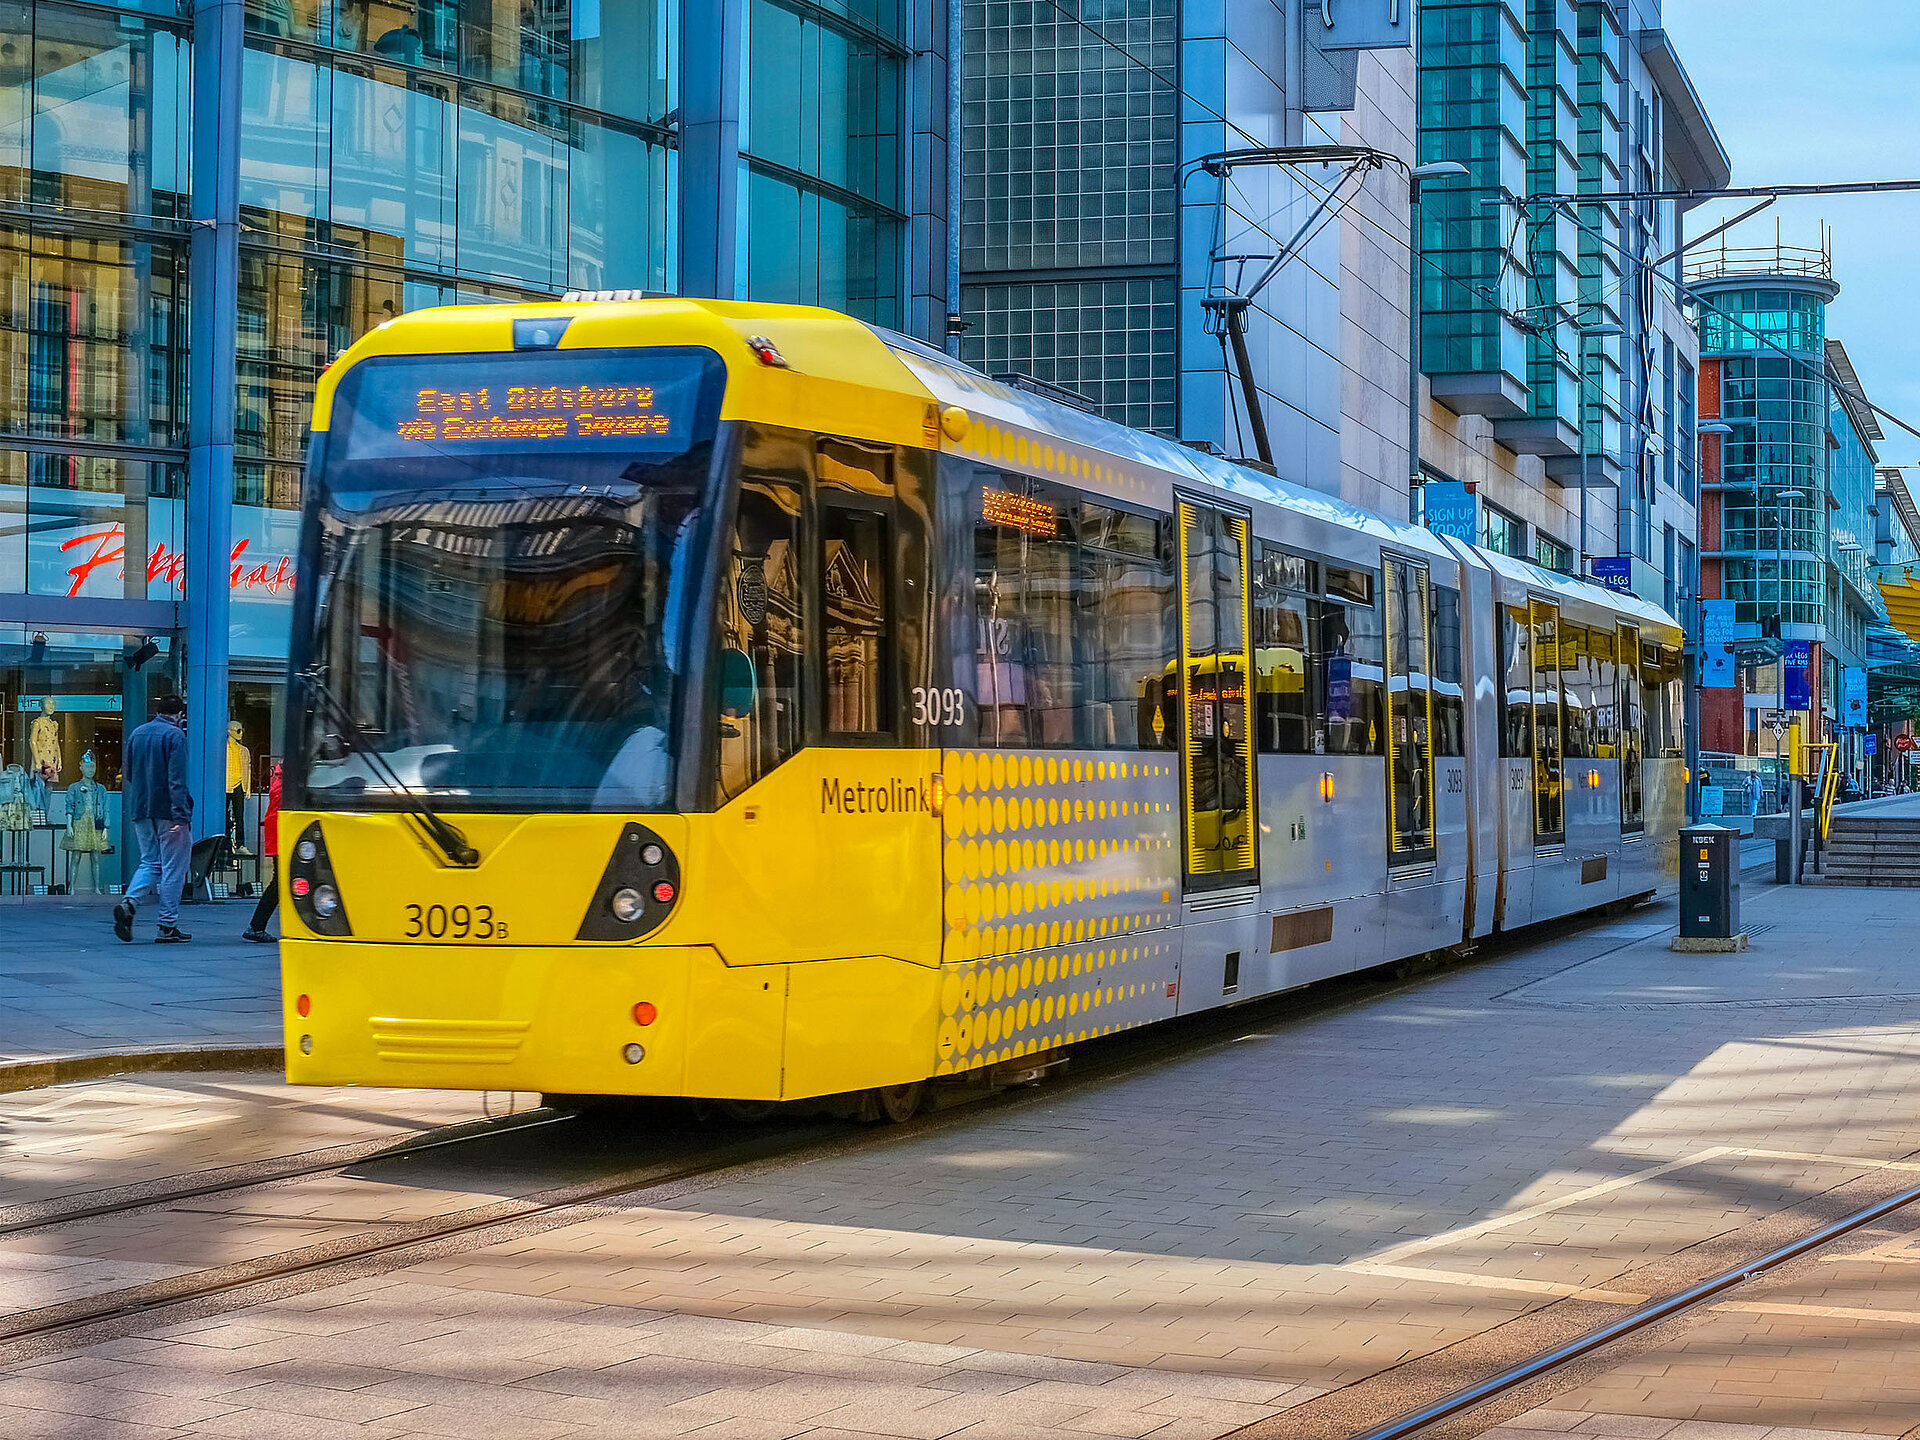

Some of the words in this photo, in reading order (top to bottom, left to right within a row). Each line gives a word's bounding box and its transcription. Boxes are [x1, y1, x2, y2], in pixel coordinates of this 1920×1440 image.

[417, 388, 490, 413] East
[1428, 508, 1455, 521] SIGN
[1458, 507, 1473, 520] UP
[1428, 522, 1473, 537] TODAY
[1608, 575, 1629, 585] LEGS
[1706, 628, 1720, 636] DOG
[912, 687, 964, 726] 3093
[1447, 769, 1463, 793] 3093
[1511, 768, 1524, 790] 3093
[821, 778, 930, 814] Metrolink
